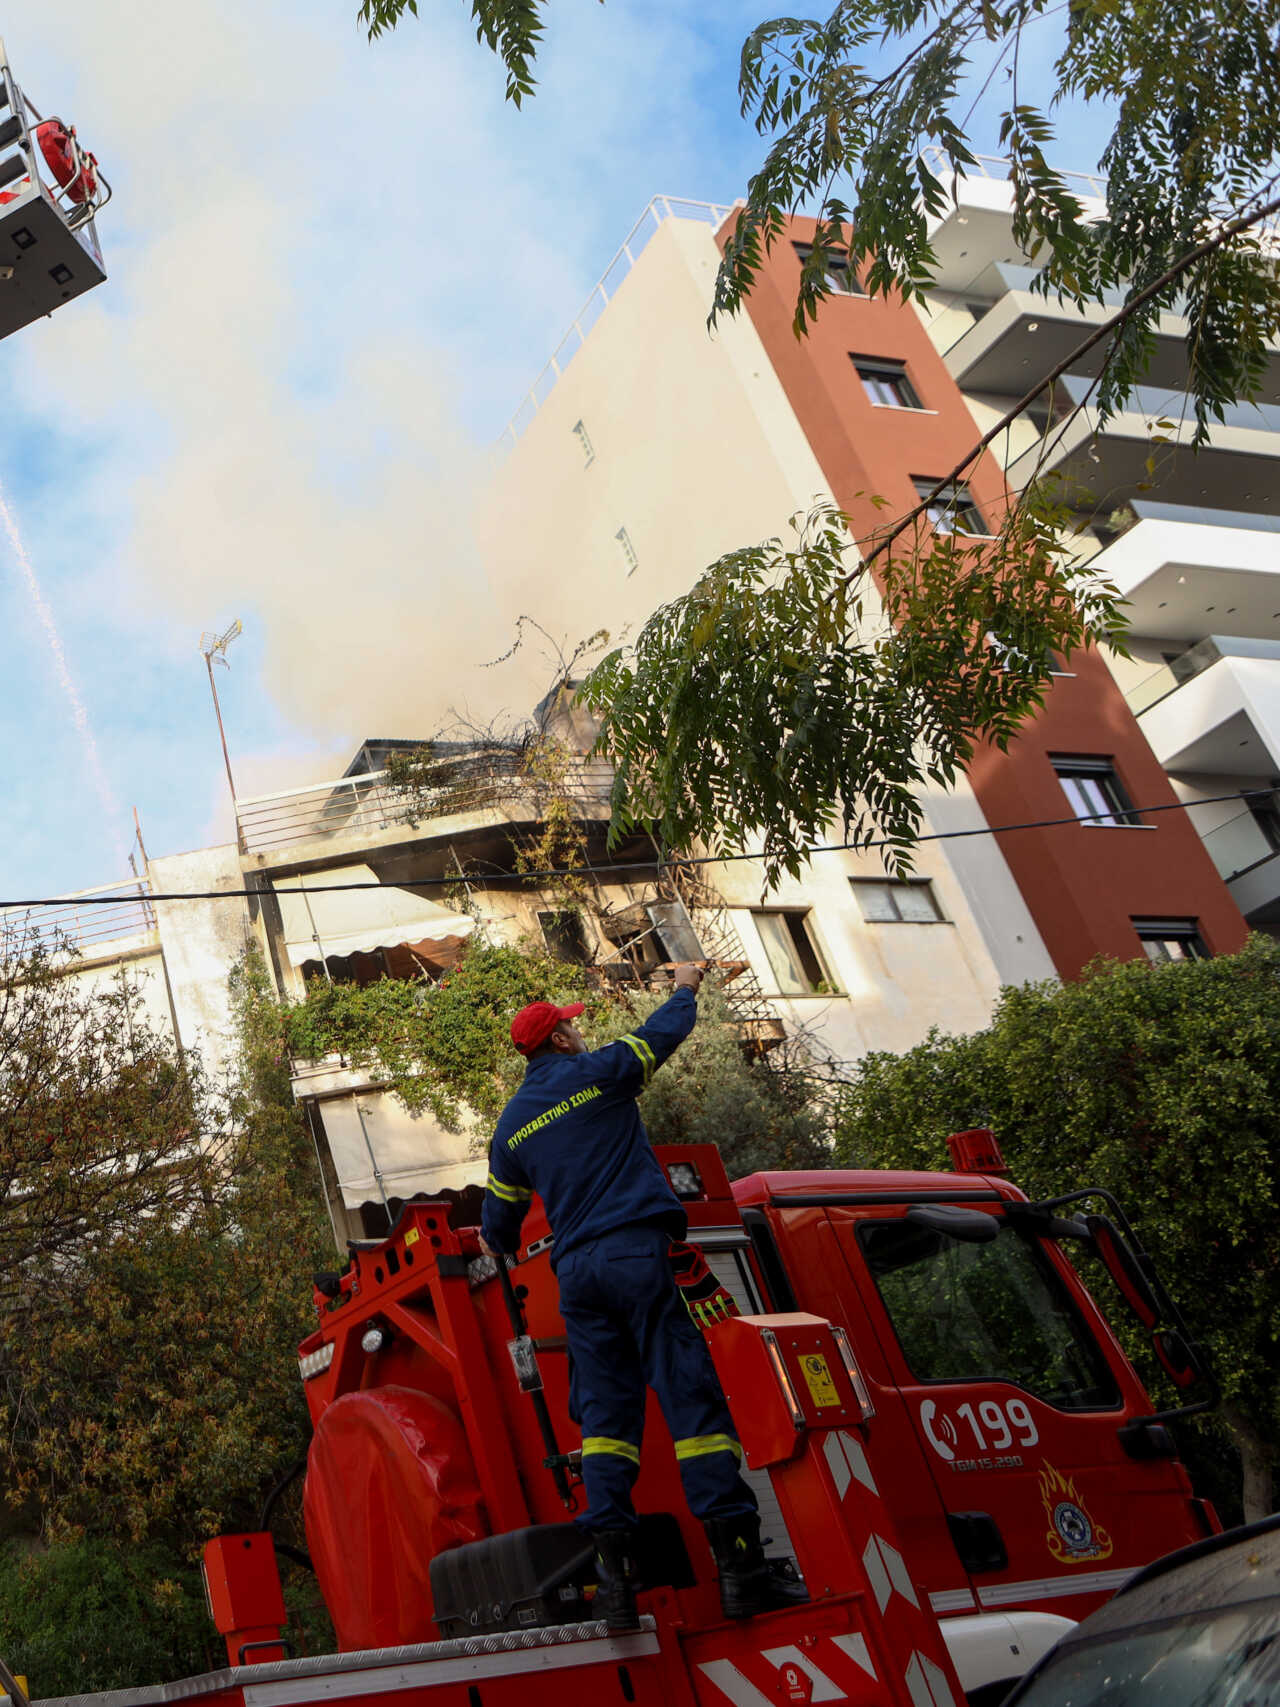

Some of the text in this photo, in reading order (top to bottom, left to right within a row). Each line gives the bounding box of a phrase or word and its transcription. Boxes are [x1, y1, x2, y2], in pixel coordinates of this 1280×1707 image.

[507, 1086, 602, 1151] ΠΥΡΟΣΒΕΣΤΙΚΟ ΣΩΜΑ
[956, 1399, 1039, 1450] 199
